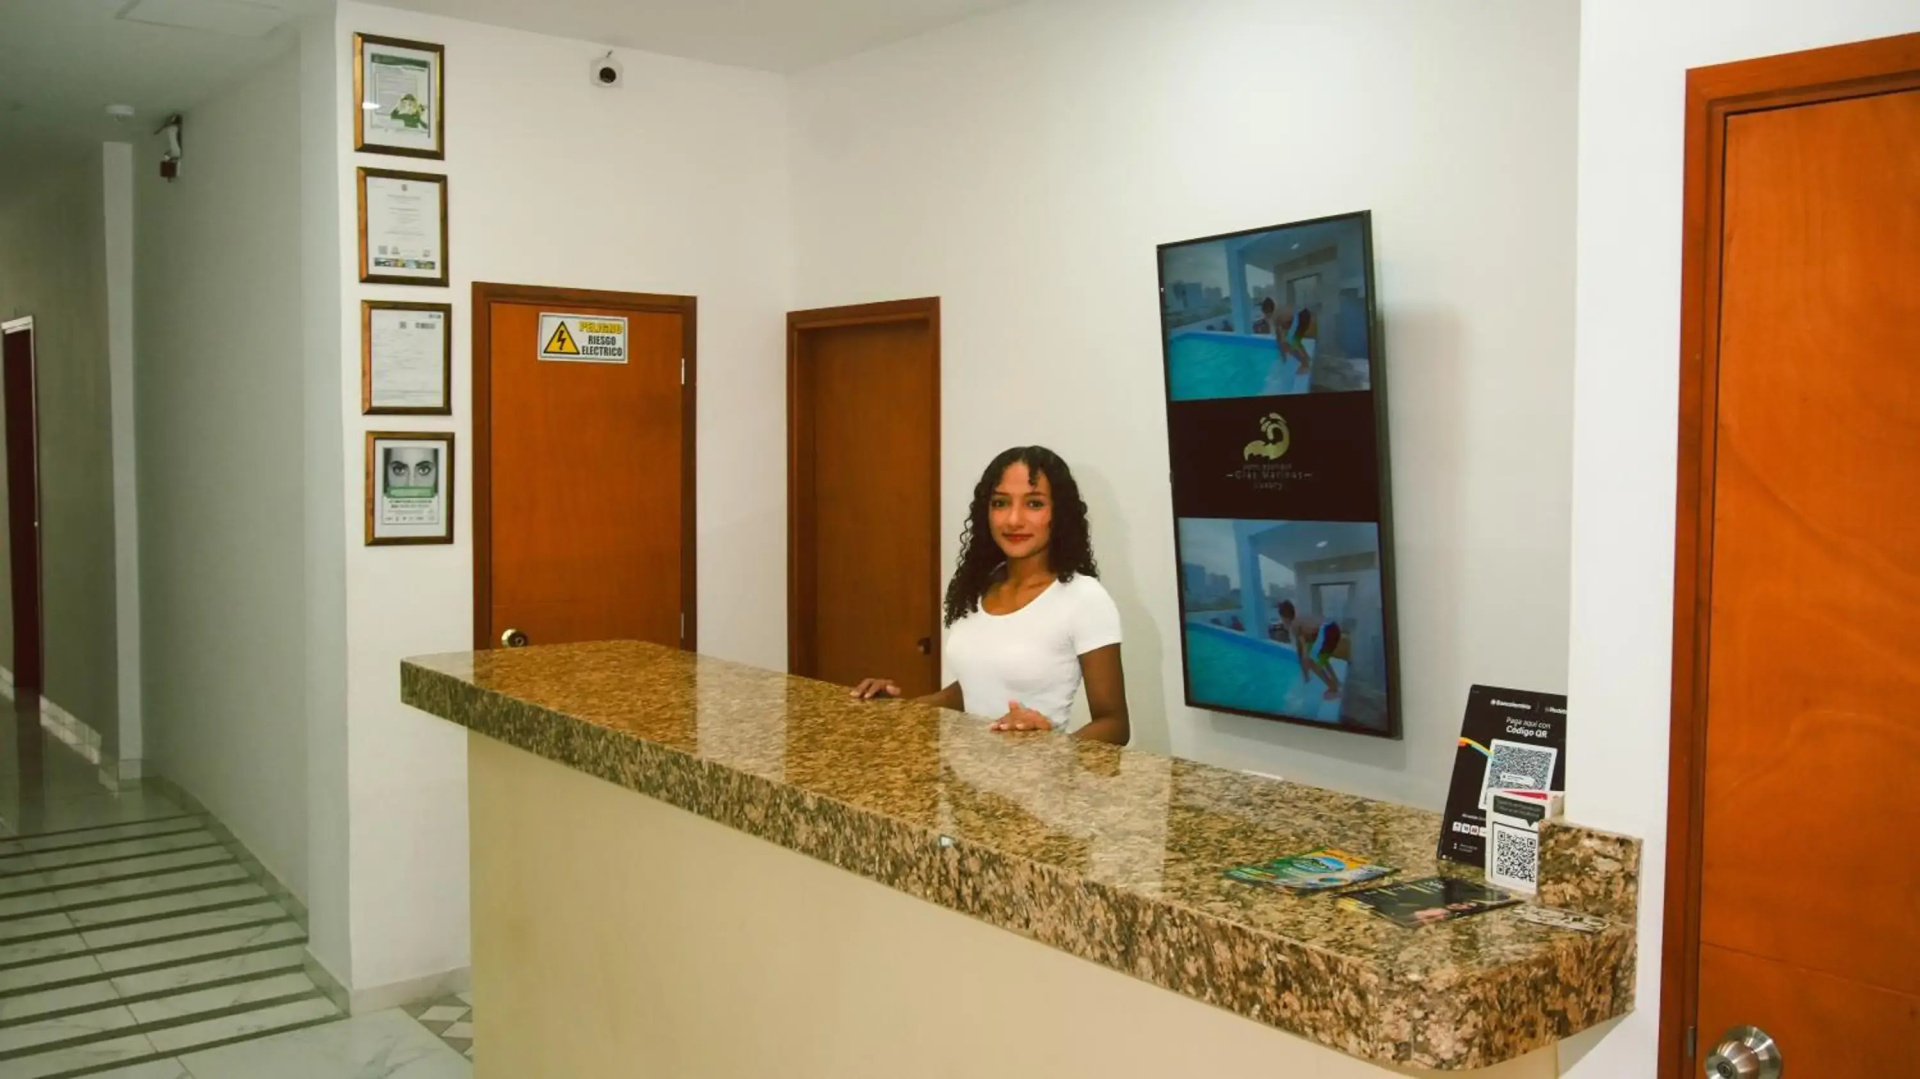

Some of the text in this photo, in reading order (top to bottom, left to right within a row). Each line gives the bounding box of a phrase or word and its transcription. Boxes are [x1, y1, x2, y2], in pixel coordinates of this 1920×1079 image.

[588, 335, 616, 345] RIESGO
[582, 346, 622, 356] ELECTRICO
[1506, 716, 1523, 728] Paga
[1538, 722, 1551, 730] con
[1535, 729, 1548, 738] QR
